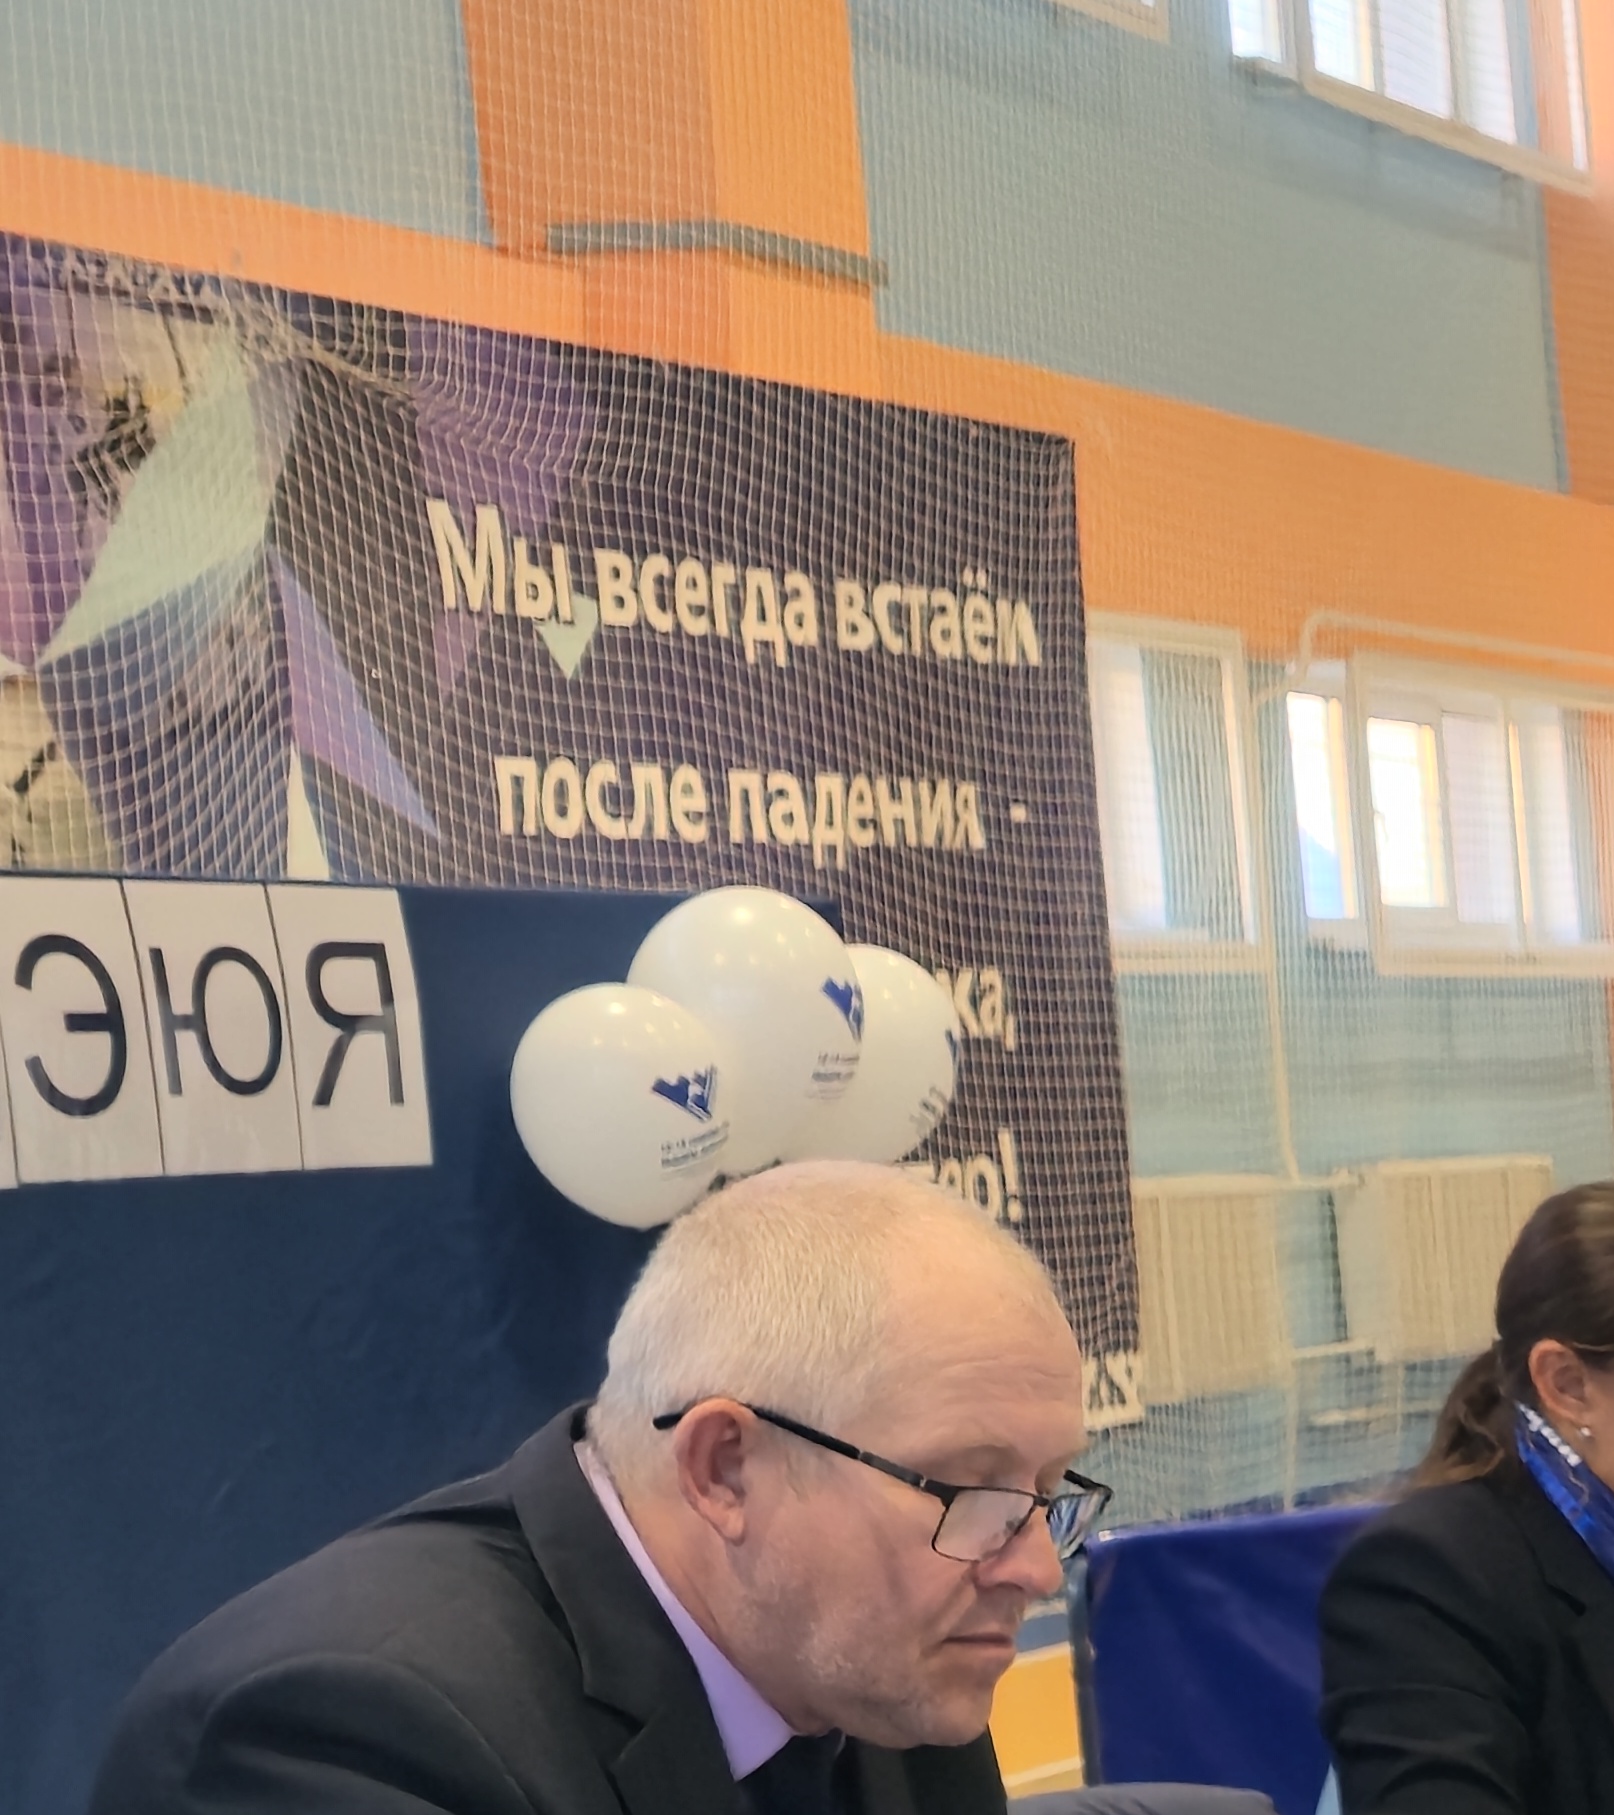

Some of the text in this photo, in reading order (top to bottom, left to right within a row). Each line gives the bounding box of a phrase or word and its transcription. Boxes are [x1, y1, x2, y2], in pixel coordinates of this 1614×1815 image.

[427, 499, 574, 625] Мы
[594, 546, 817, 667] всегда
[495, 755, 708, 844] после
[728, 767, 986, 870] падения
